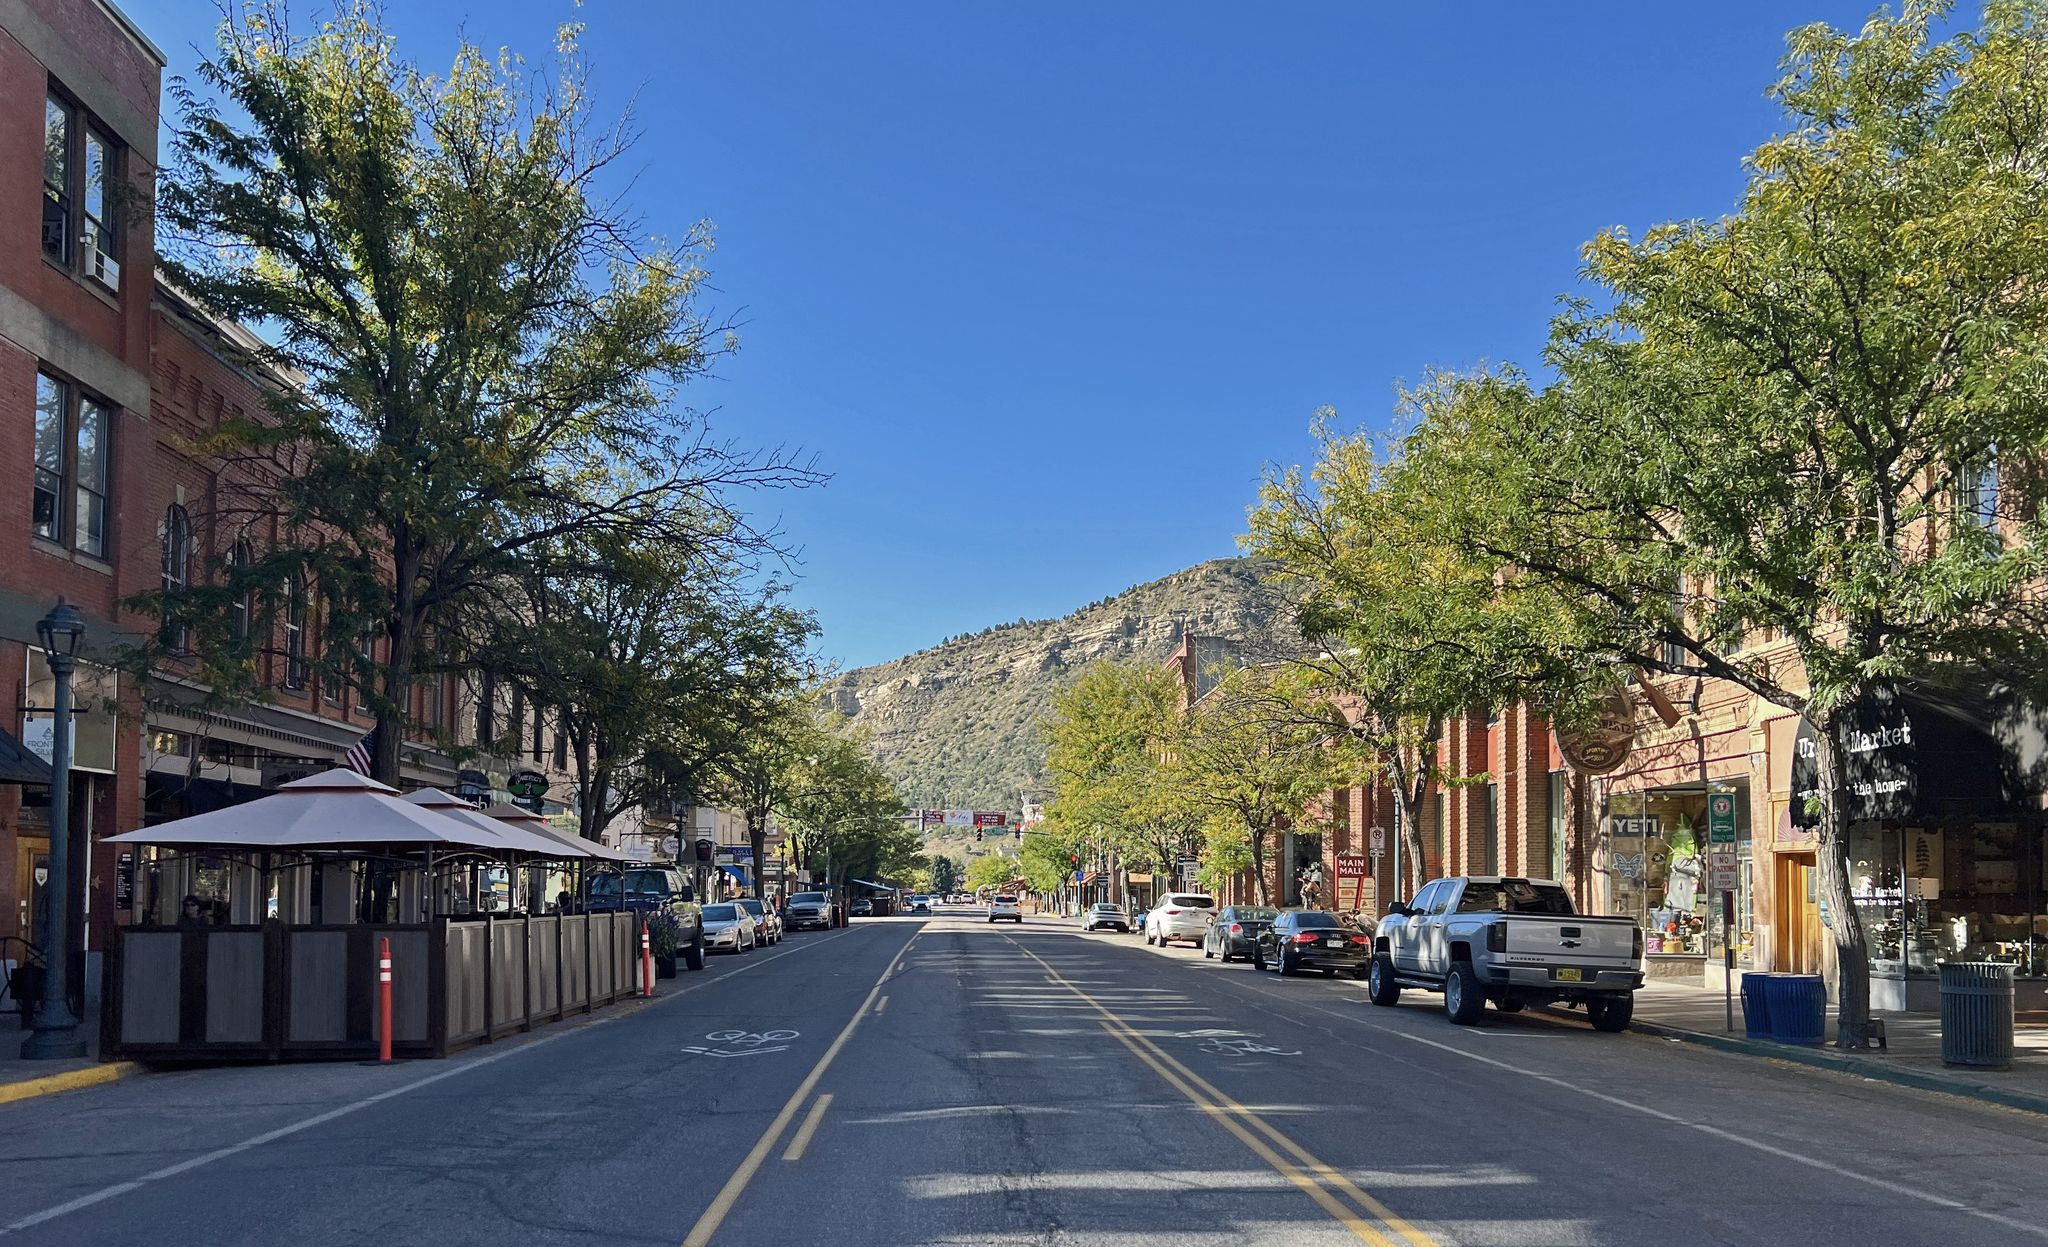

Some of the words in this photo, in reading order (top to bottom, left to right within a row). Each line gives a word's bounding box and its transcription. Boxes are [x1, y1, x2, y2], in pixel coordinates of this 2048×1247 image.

[1849, 722, 1911, 753] Market
[27, 740, 53, 748] FRONT
[1853, 782, 1871, 796] the
[1875, 779, 1907, 794] home-
[1613, 819, 1657, 833] YETI
[1338, 859, 1365, 867] MAIN
[1719, 856, 1729, 864] NO
[1339, 867, 1364, 875] MALL
[1713, 865, 1736, 873] PARKING
[1875, 887, 1902, 898] Market
